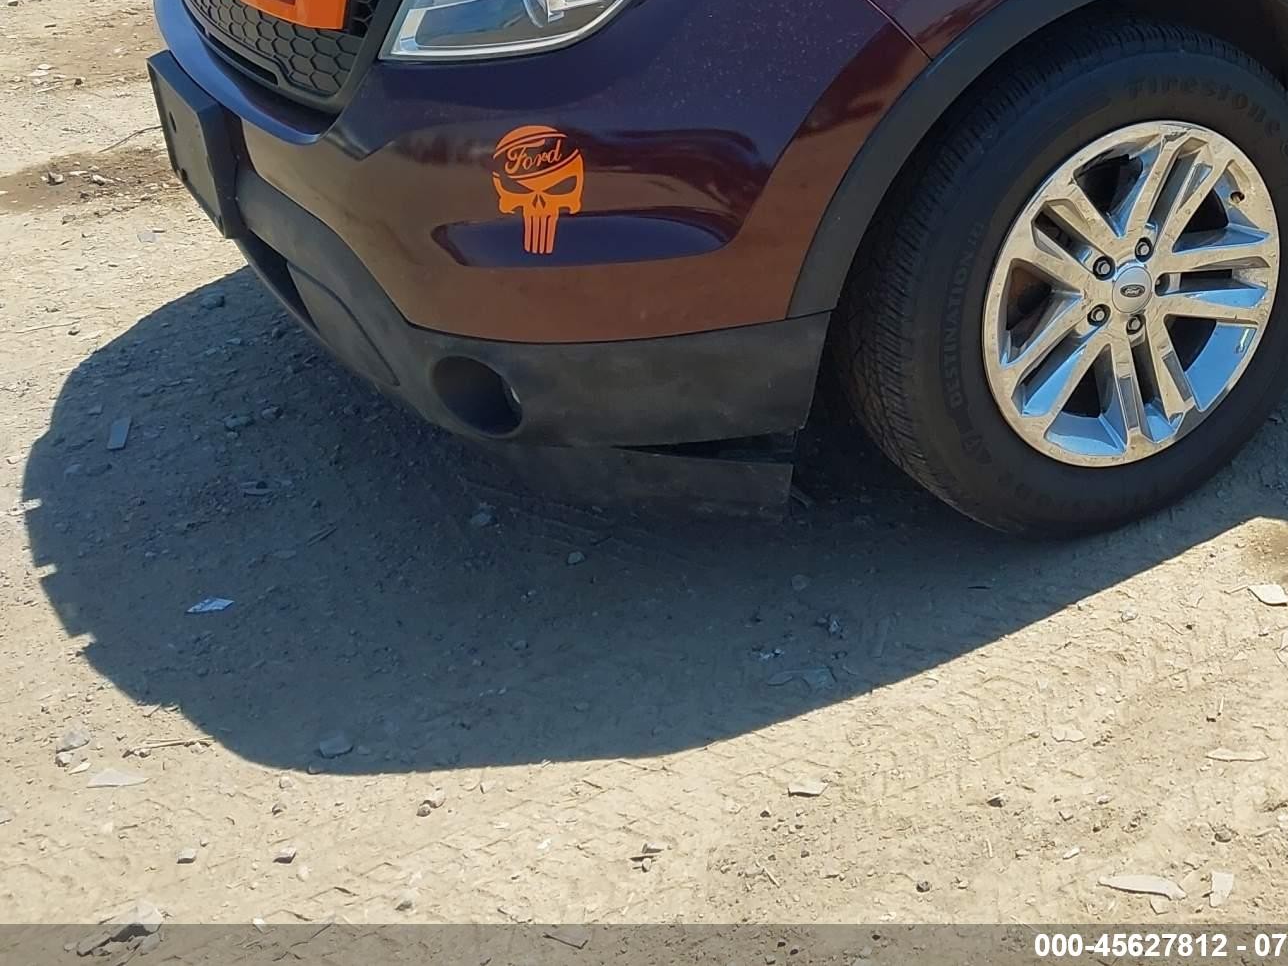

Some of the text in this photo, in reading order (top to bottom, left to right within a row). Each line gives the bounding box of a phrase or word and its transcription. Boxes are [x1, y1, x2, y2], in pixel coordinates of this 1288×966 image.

[1126, 73, 1282, 139] Firestone
[505, 138, 562, 174] Ford
[943, 250, 977, 408] DESTINATION
